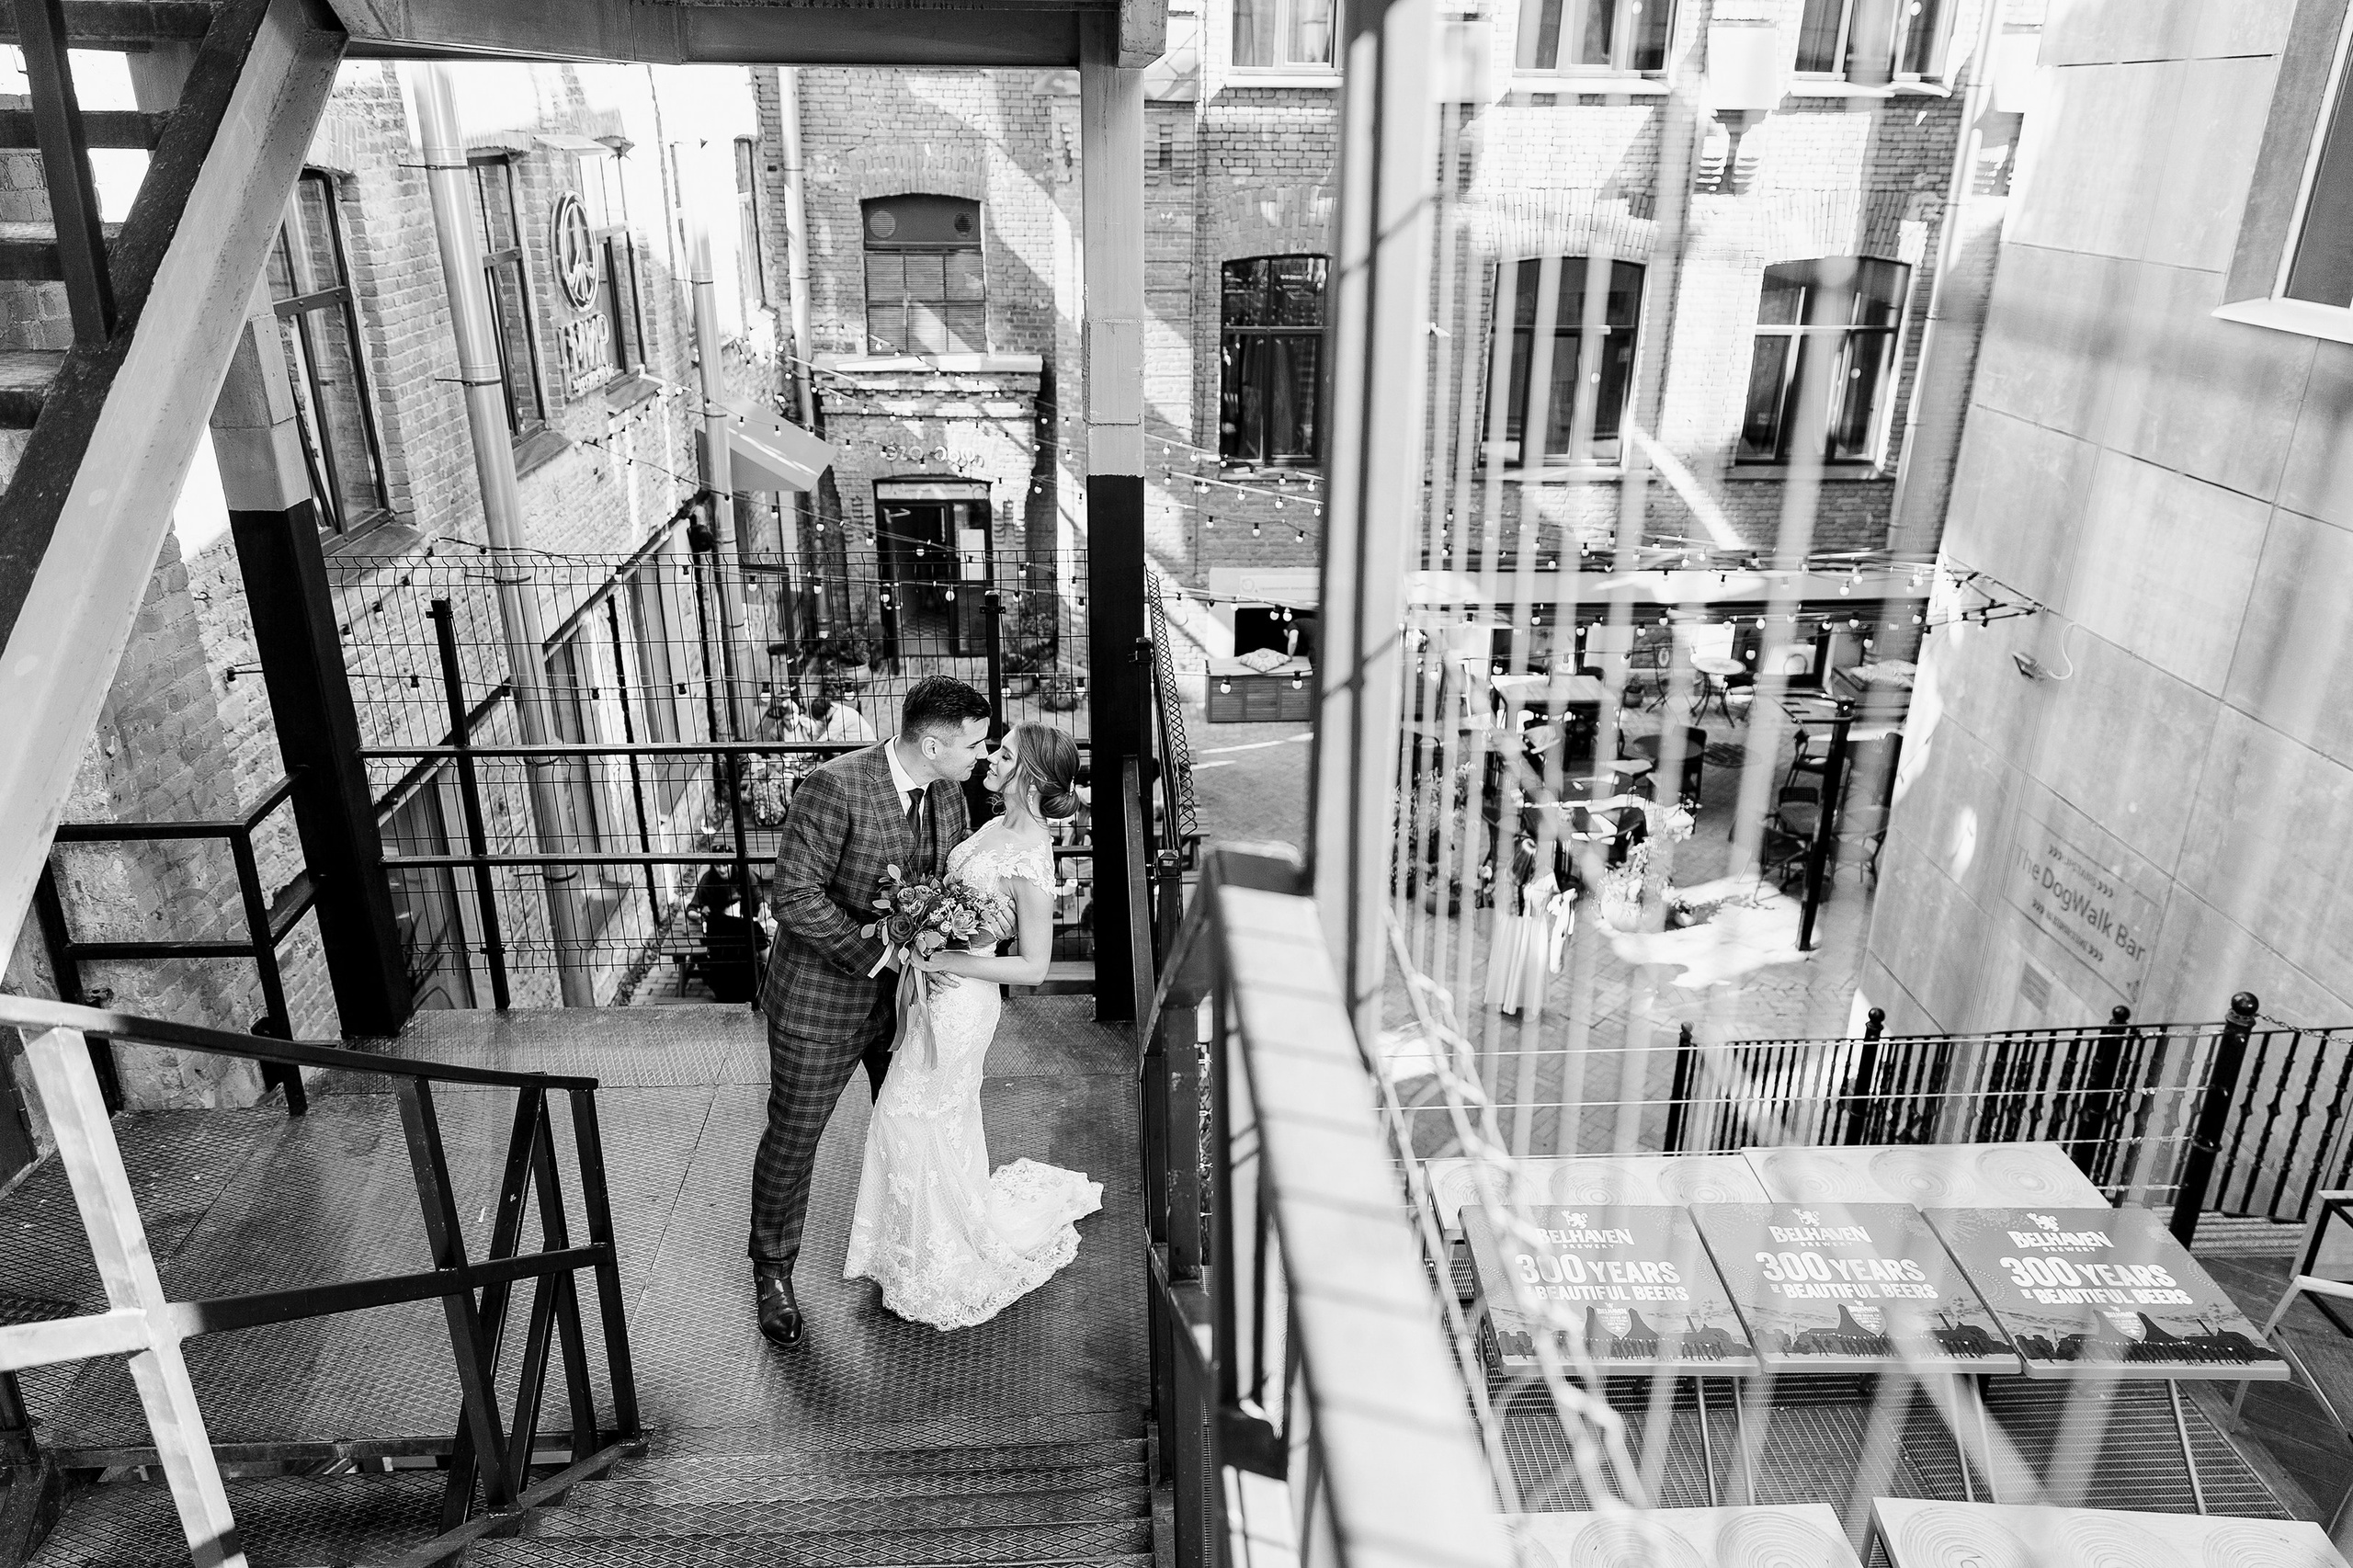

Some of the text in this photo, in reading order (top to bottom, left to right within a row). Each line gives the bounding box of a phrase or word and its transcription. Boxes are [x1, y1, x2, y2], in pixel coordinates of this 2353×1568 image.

[2017, 843, 2040, 881] The
[2041, 866, 2113, 938] DogWalk
[2115, 923, 2146, 961] Bar
[1537, 1228, 1635, 1245] BELHAVEN
[1768, 1225, 1873, 1244] BELHAVEN
[2006, 1231, 2115, 1248] BELHAVEN
[1515, 1254, 1681, 1284] 300 YEARS
[1755, 1251, 1927, 1282] 300 YEARS
[1999, 1256, 2177, 1288] 300 YEARS
[1534, 1285, 1631, 1301] BEAUTIFUL
[1631, 1285, 1690, 1301] BEERS
[1781, 1283, 1881, 1299] BEAUTIFUL
[1879, 1283, 1939, 1300] BEERS
[2031, 1289, 2135, 1304] BEAUTIFUL
[2130, 1289, 2194, 1305] BEERS
